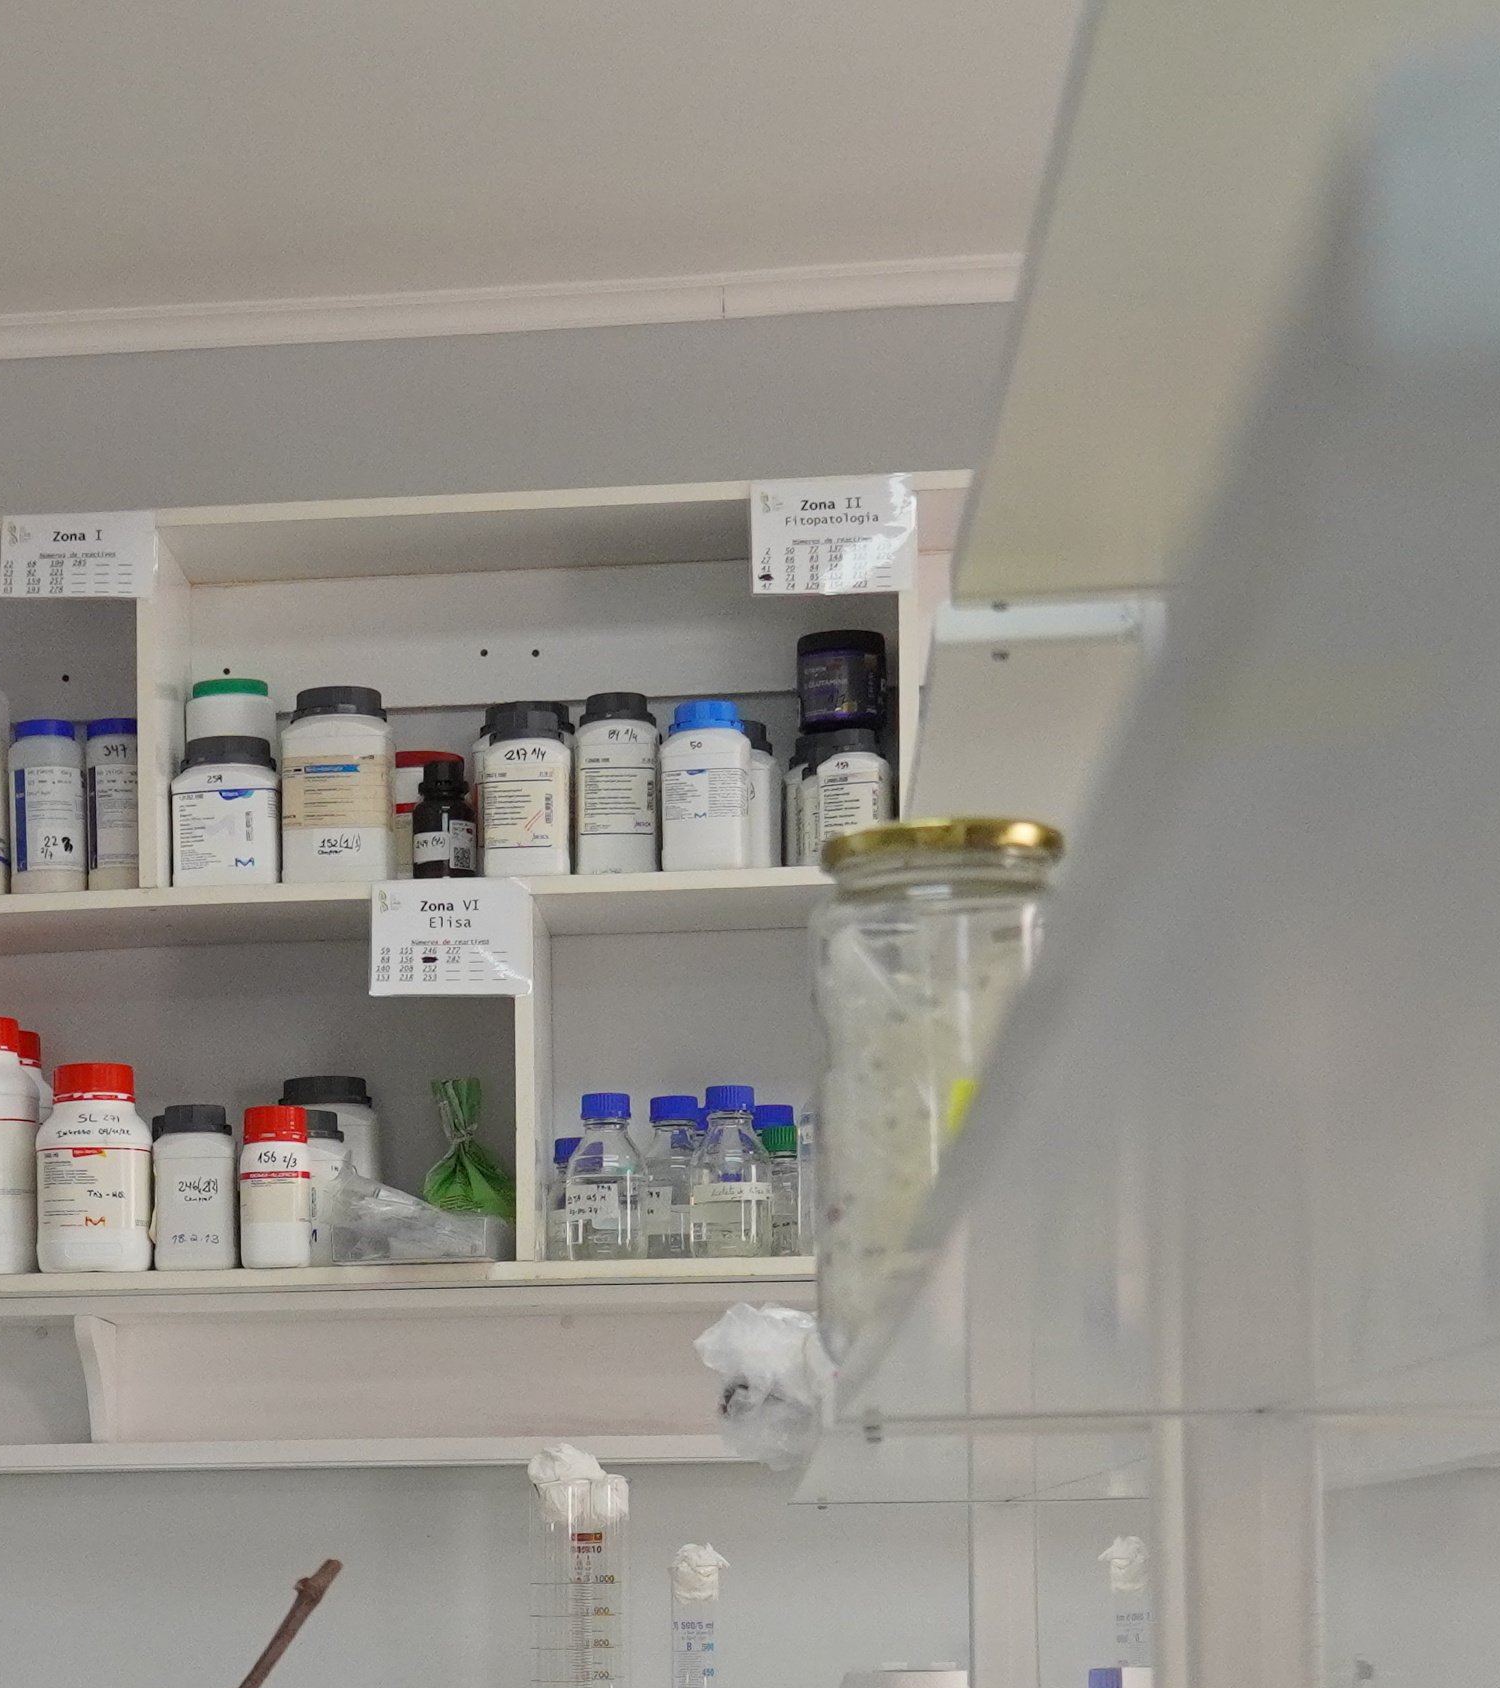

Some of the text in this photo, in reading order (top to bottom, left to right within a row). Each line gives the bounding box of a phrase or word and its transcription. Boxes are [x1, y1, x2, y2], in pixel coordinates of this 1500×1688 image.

[801, 497, 862, 511] Zona II
[52, 529, 102, 542] Zona I
[104, 743, 128, 758] 347
[690, 741, 702, 749] 50
[420, 899, 480, 912] Zona VI
[429, 916, 472, 928] Elisa
[258, 1151, 277, 1163] 156
[594, 1575, 614, 1583] 1000
